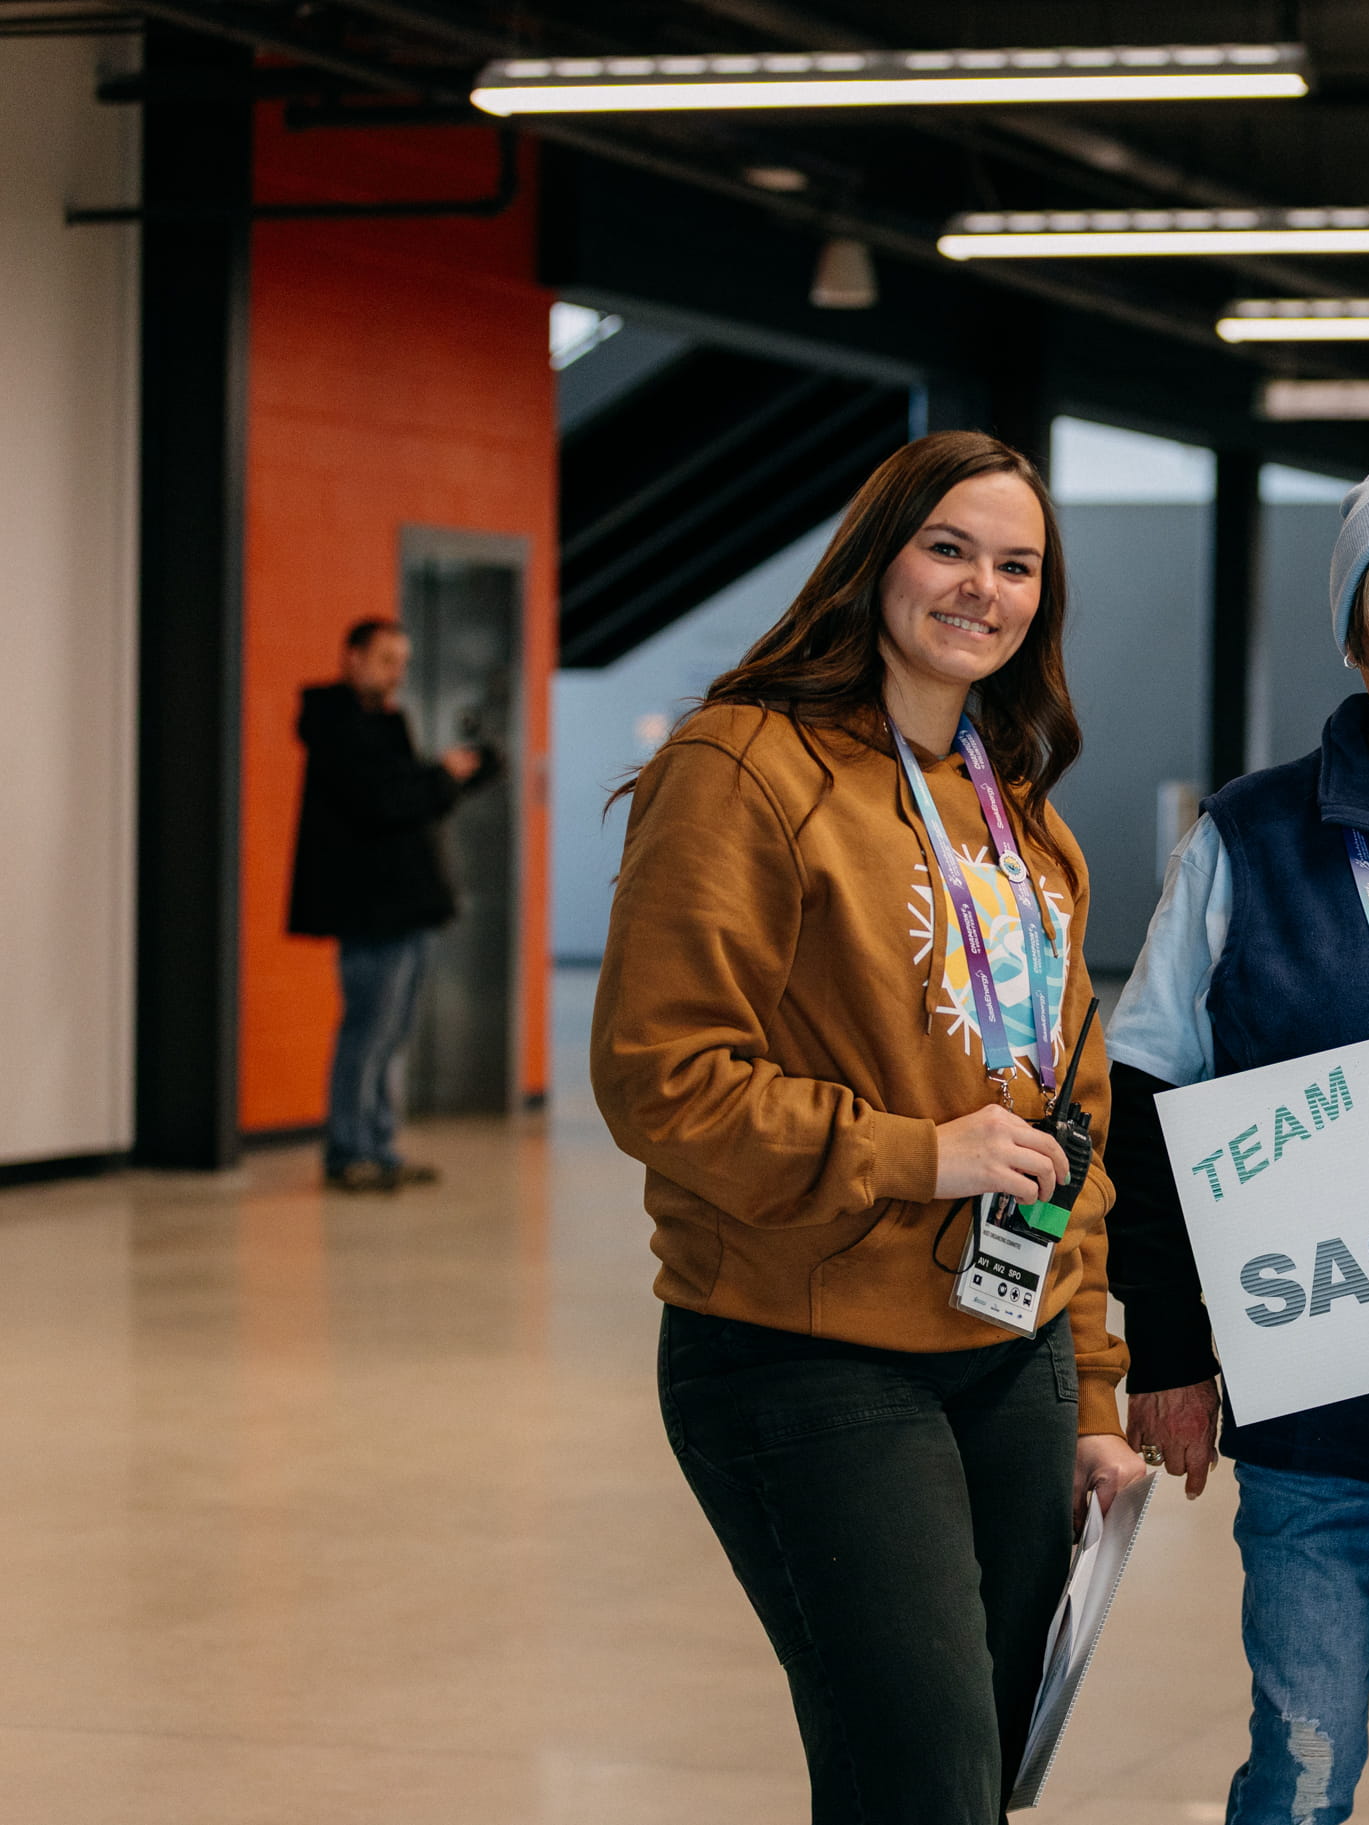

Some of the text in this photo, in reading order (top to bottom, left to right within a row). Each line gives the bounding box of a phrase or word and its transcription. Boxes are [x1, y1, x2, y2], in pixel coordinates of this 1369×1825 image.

[986, 785, 1004, 830] SaskEnergy
[979, 971, 996, 1024] SaskEnergy
[1191, 1065, 1354, 1203] TEAM
[977, 1256, 1022, 1281] AV1 AV2 SPO
